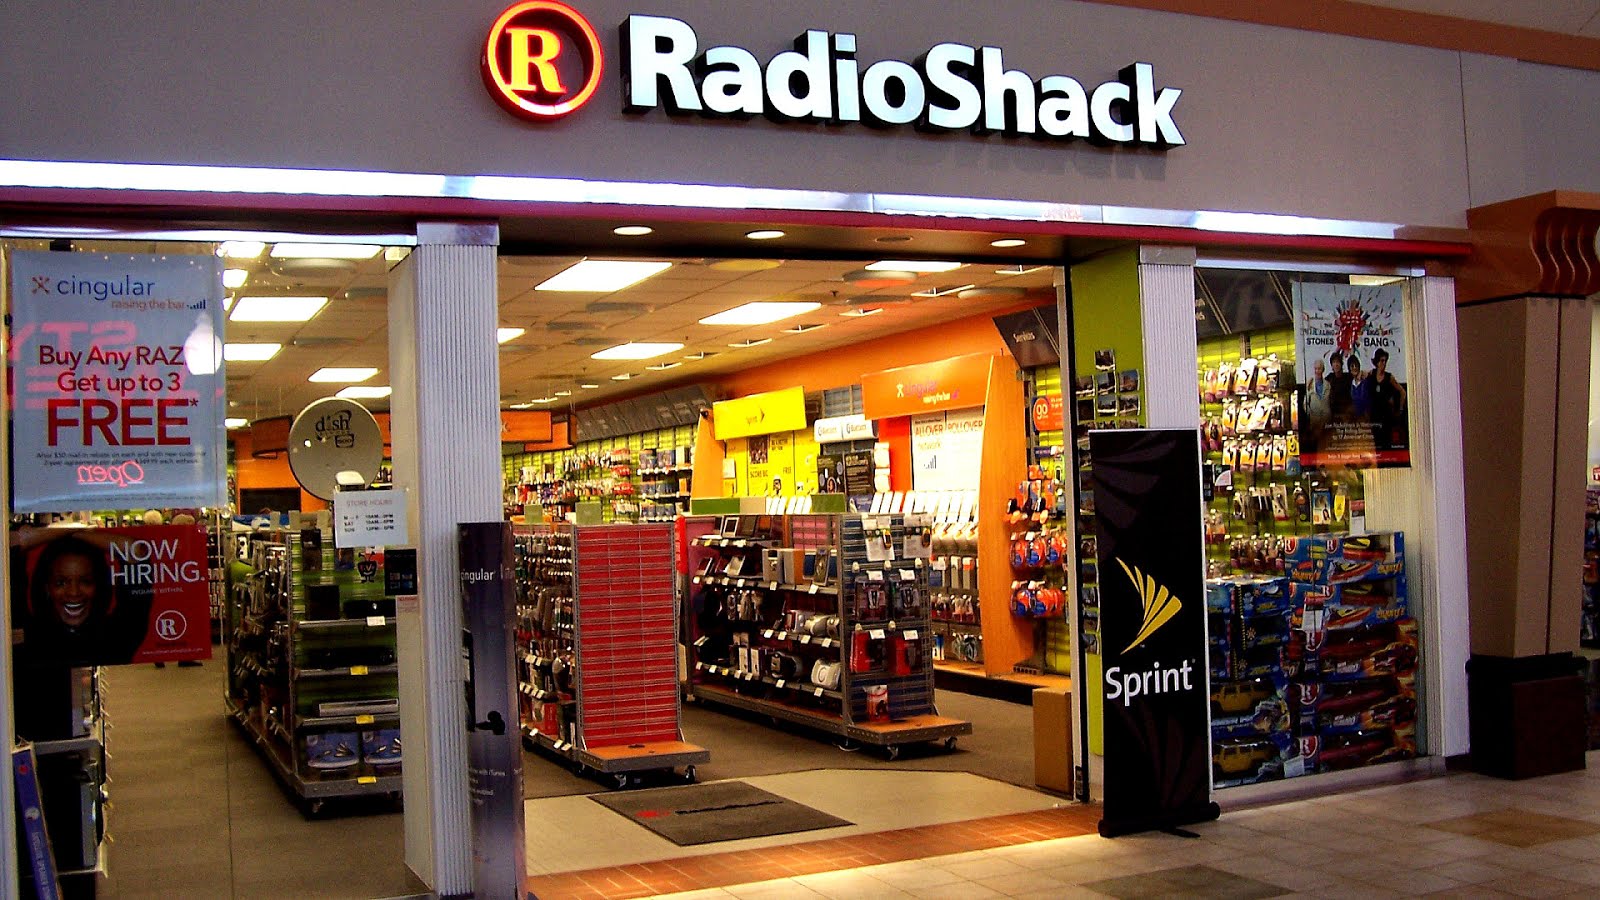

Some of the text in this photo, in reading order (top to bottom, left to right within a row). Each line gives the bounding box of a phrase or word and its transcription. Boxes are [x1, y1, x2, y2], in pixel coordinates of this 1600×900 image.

[627, 14, 1186, 145] RadioShack
[57, 275, 155, 301] cingular
[111, 299, 185, 310] raising the bar
[1306, 337, 1334, 345] STONES
[1363, 337, 1390, 347] BANG
[39, 345, 83, 370] Buy
[86, 345, 131, 371] Any
[57, 373, 100, 392] Get
[107, 374, 136, 396] up
[140, 373, 163, 391] to
[167, 373, 181, 391] 3
[1036, 404, 1048, 420] go
[315, 416, 349, 432] dish
[109, 538, 179, 562] NOW
[110, 561, 206, 586] HIRING.
[1105, 660, 1193, 707] Sprint
